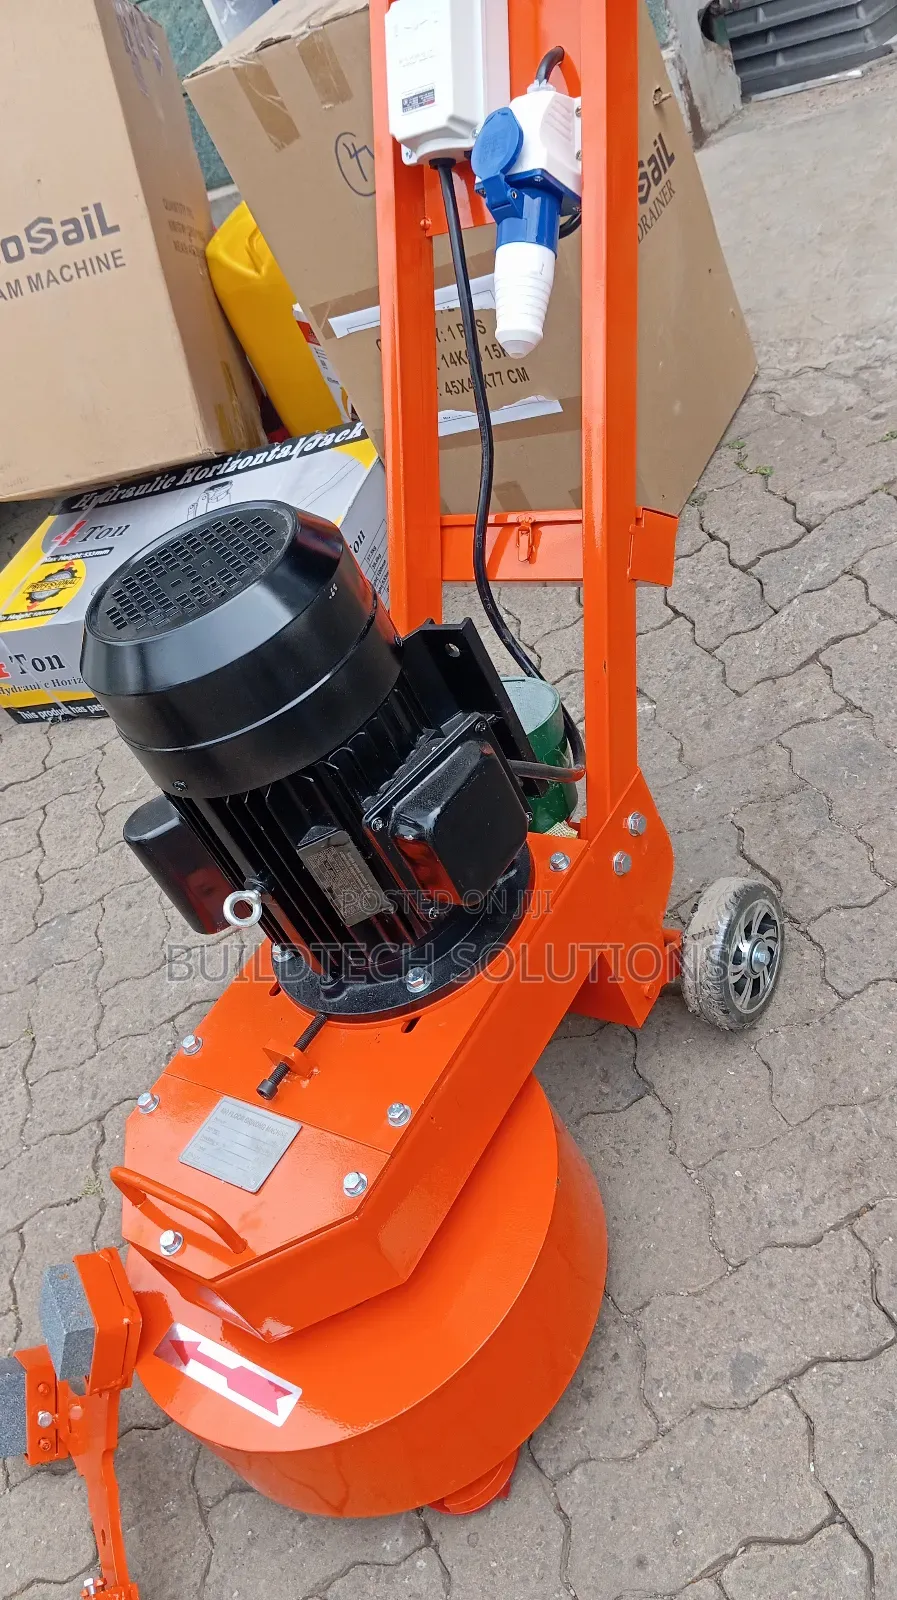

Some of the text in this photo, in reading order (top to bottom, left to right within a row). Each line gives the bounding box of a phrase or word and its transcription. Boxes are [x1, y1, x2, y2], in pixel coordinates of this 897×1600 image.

[27, 248, 126, 293] MACHINE
[456, 319, 487, 339] PS
[441, 349, 469, 368] 14K
[445, 366, 530, 396] 45X4X77 CM
[71, 421, 365, 511] Hydraulic Horizontal Jack
[76, 524, 131, 543] Ton
[349, 530, 366, 554] on
[8, 653, 66, 675] Ton
[18, 709, 37, 720] This
[68, 703, 88, 714] has
